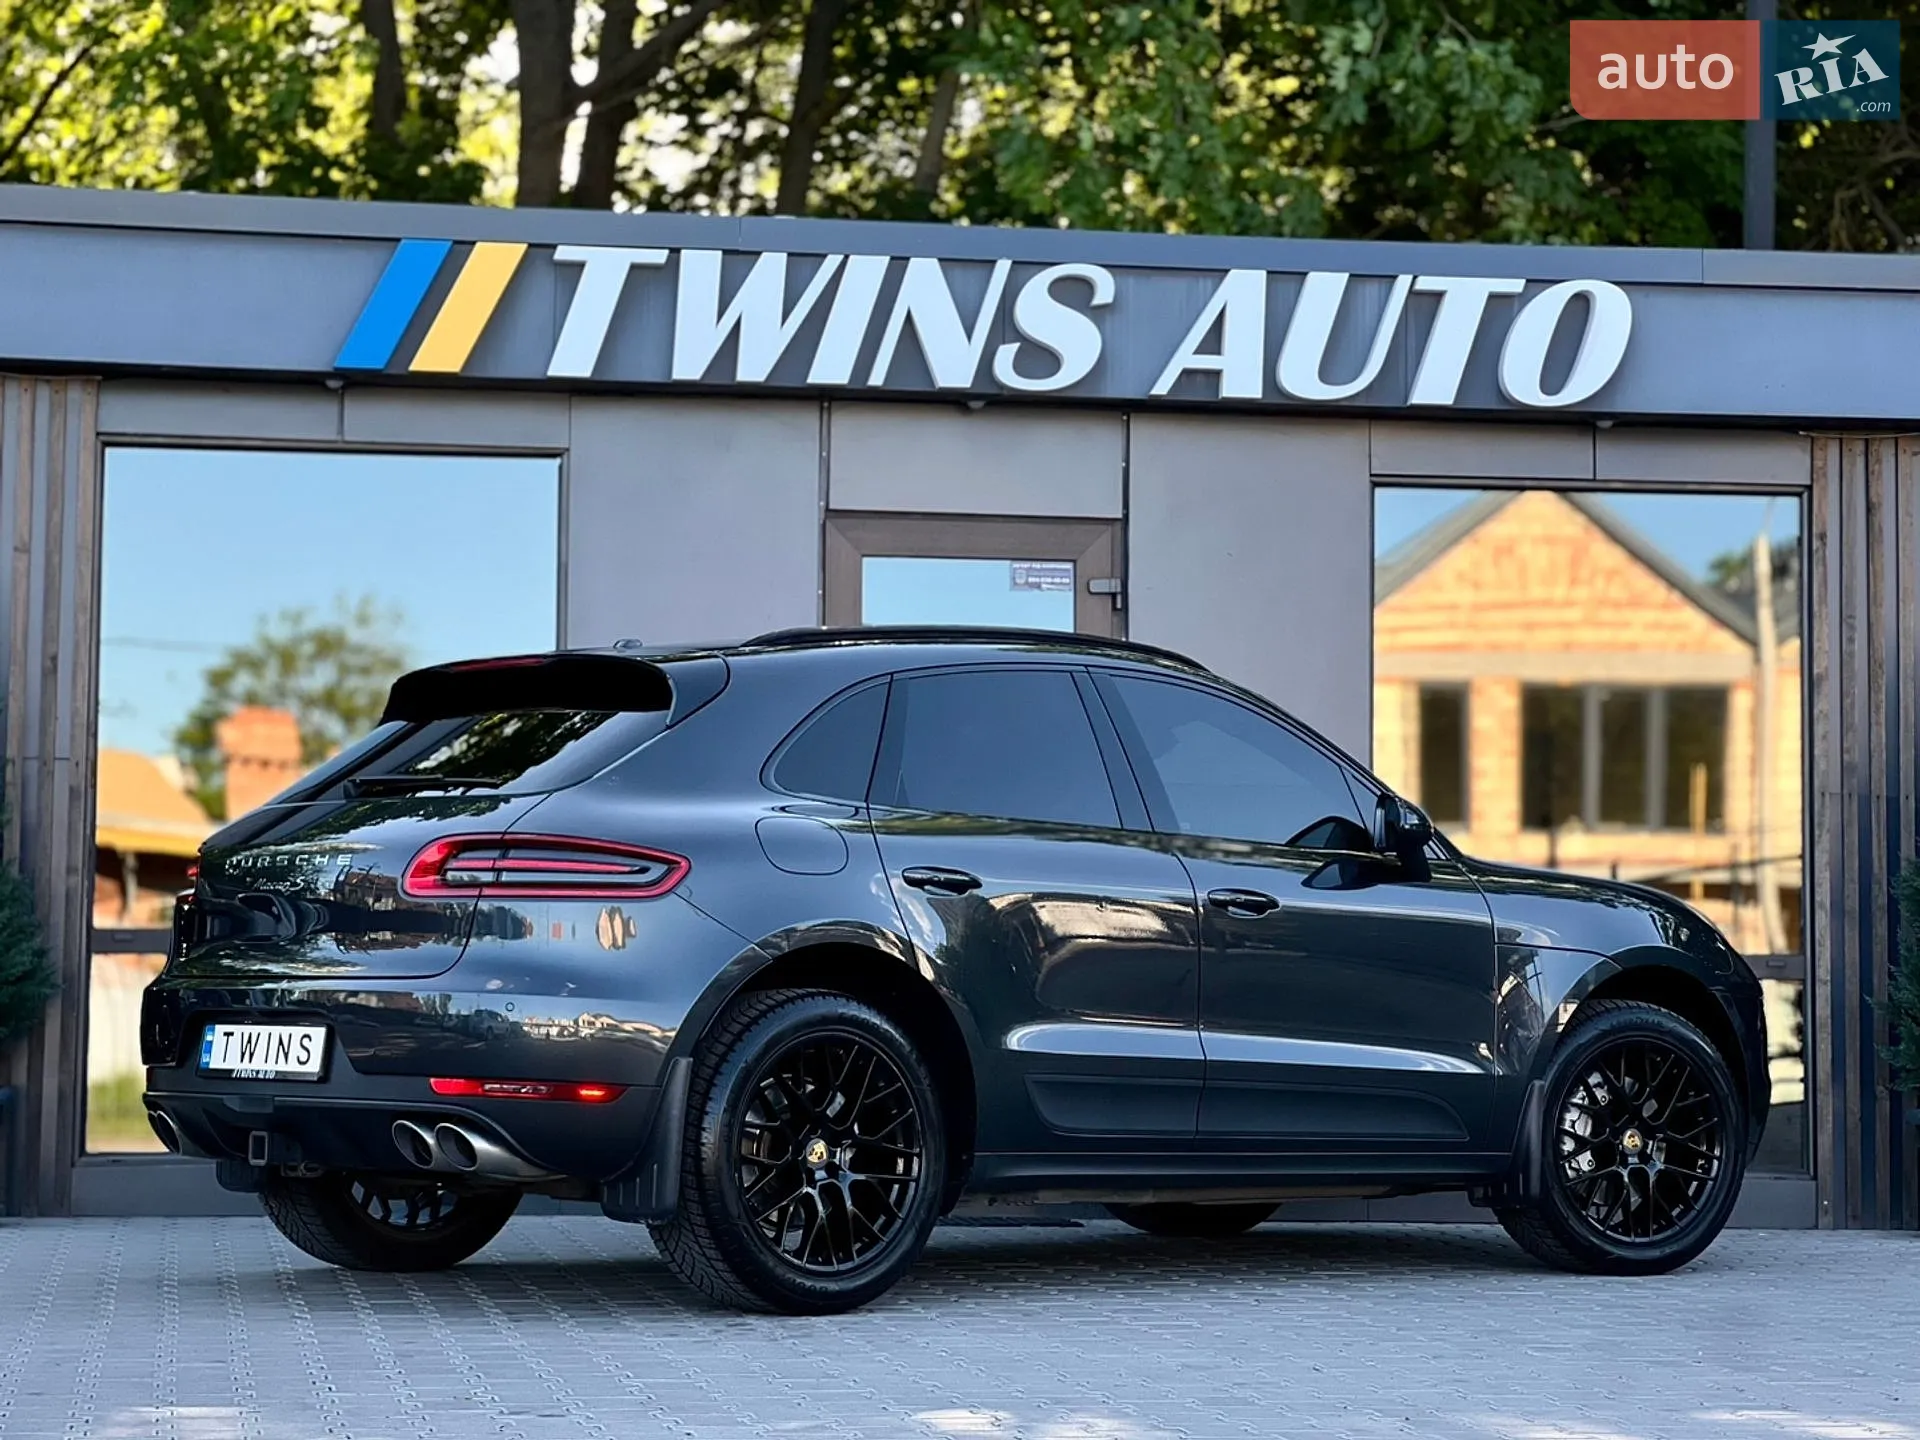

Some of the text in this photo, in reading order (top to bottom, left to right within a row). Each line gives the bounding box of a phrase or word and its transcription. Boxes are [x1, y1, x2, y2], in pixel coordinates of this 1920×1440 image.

[546, 245, 1632, 407] TWINS AUTO
[223, 1031, 312, 1066] TWINS
